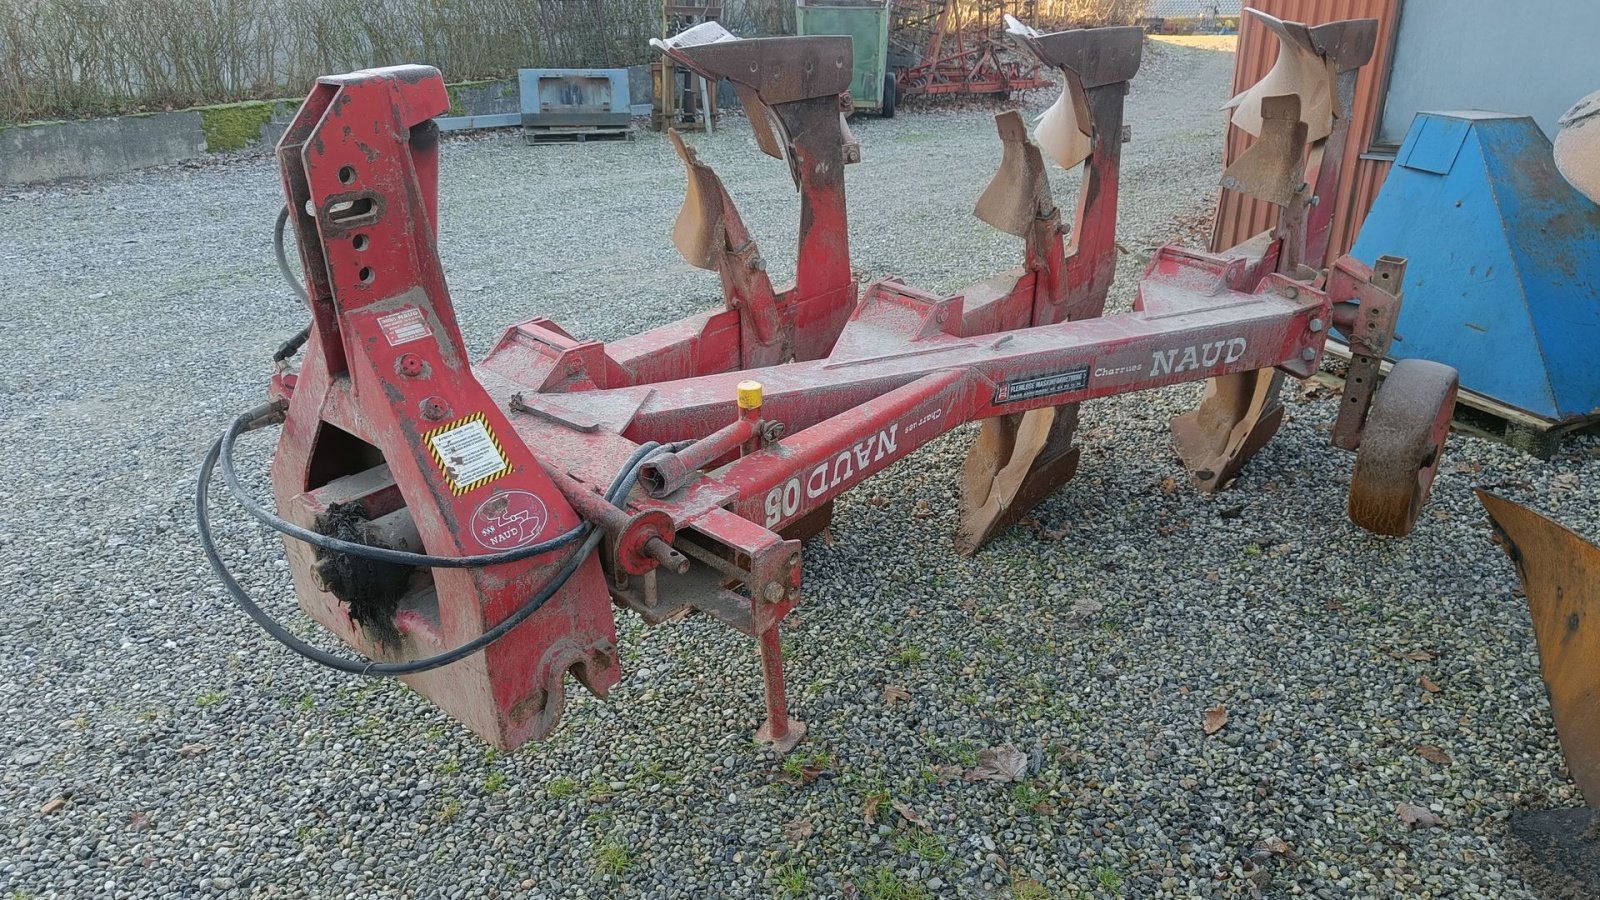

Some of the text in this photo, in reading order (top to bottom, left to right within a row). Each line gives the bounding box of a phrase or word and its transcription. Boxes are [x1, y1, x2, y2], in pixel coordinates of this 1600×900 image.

[1095, 337, 1247, 377] Charrues NAUD
[764, 408, 942, 530] Charrues NAUD 05
[489, 527, 519, 545] NAUD
